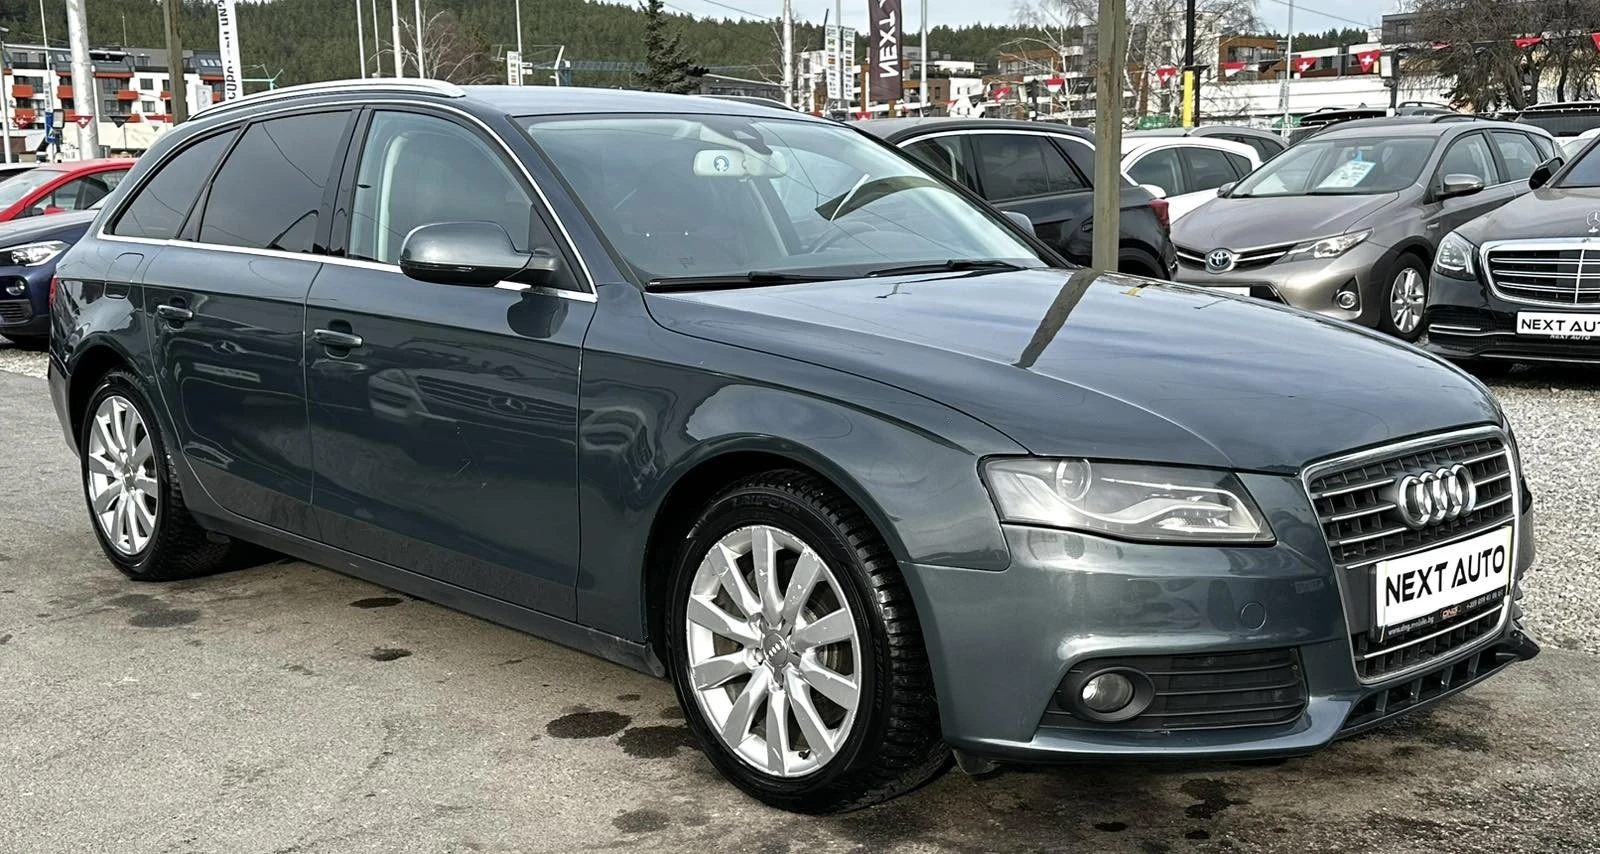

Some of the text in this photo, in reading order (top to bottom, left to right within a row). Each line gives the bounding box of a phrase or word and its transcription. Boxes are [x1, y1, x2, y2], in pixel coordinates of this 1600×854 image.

[1521, 318, 1600, 333] NEXT AU
[1385, 545, 1505, 607] NEXT AUTO
